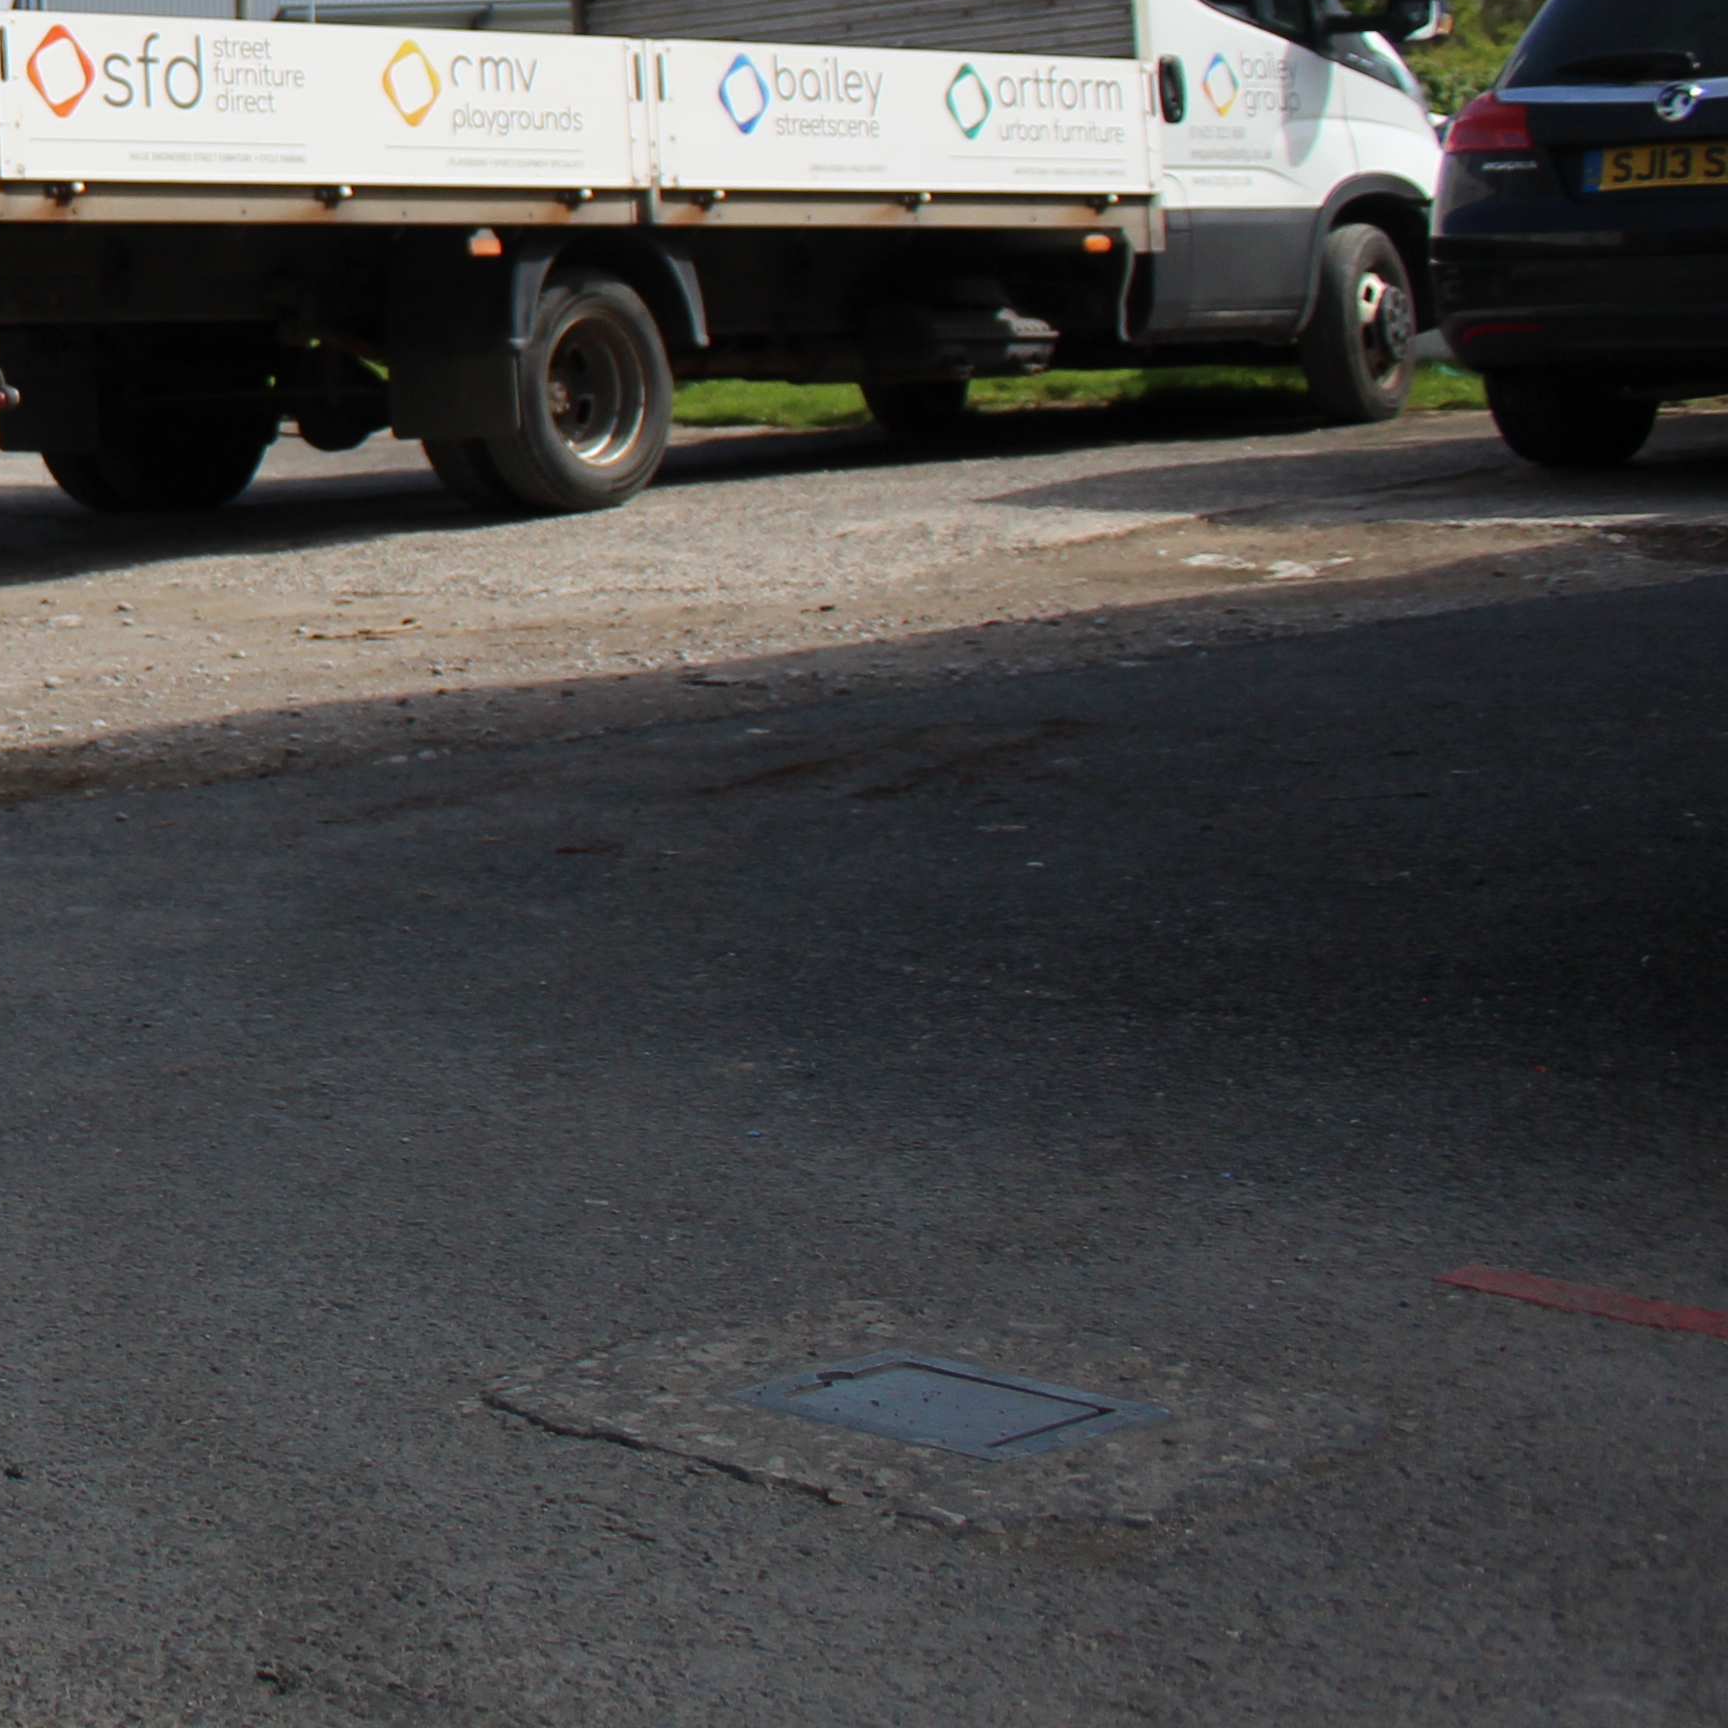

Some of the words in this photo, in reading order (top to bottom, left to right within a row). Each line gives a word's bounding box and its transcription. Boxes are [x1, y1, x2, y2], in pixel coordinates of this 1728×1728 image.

[212, 36, 273, 59] street
[103, 32, 204, 110] sfd
[214, 61, 306, 88] furniture
[1240, 50, 1296, 88] bailey
[773, 54, 883, 116] bailey
[998, 66, 1123, 109] artform
[216, 91, 276, 113] direct
[1245, 91, 1300, 118] group
[453, 102, 584, 136] playgrounds
[776, 114, 880, 138] streetscene
[999, 120, 1050, 141] urban
[1053, 120, 1126, 143] furniture
[1613, 147, 1692, 182] SJ13
